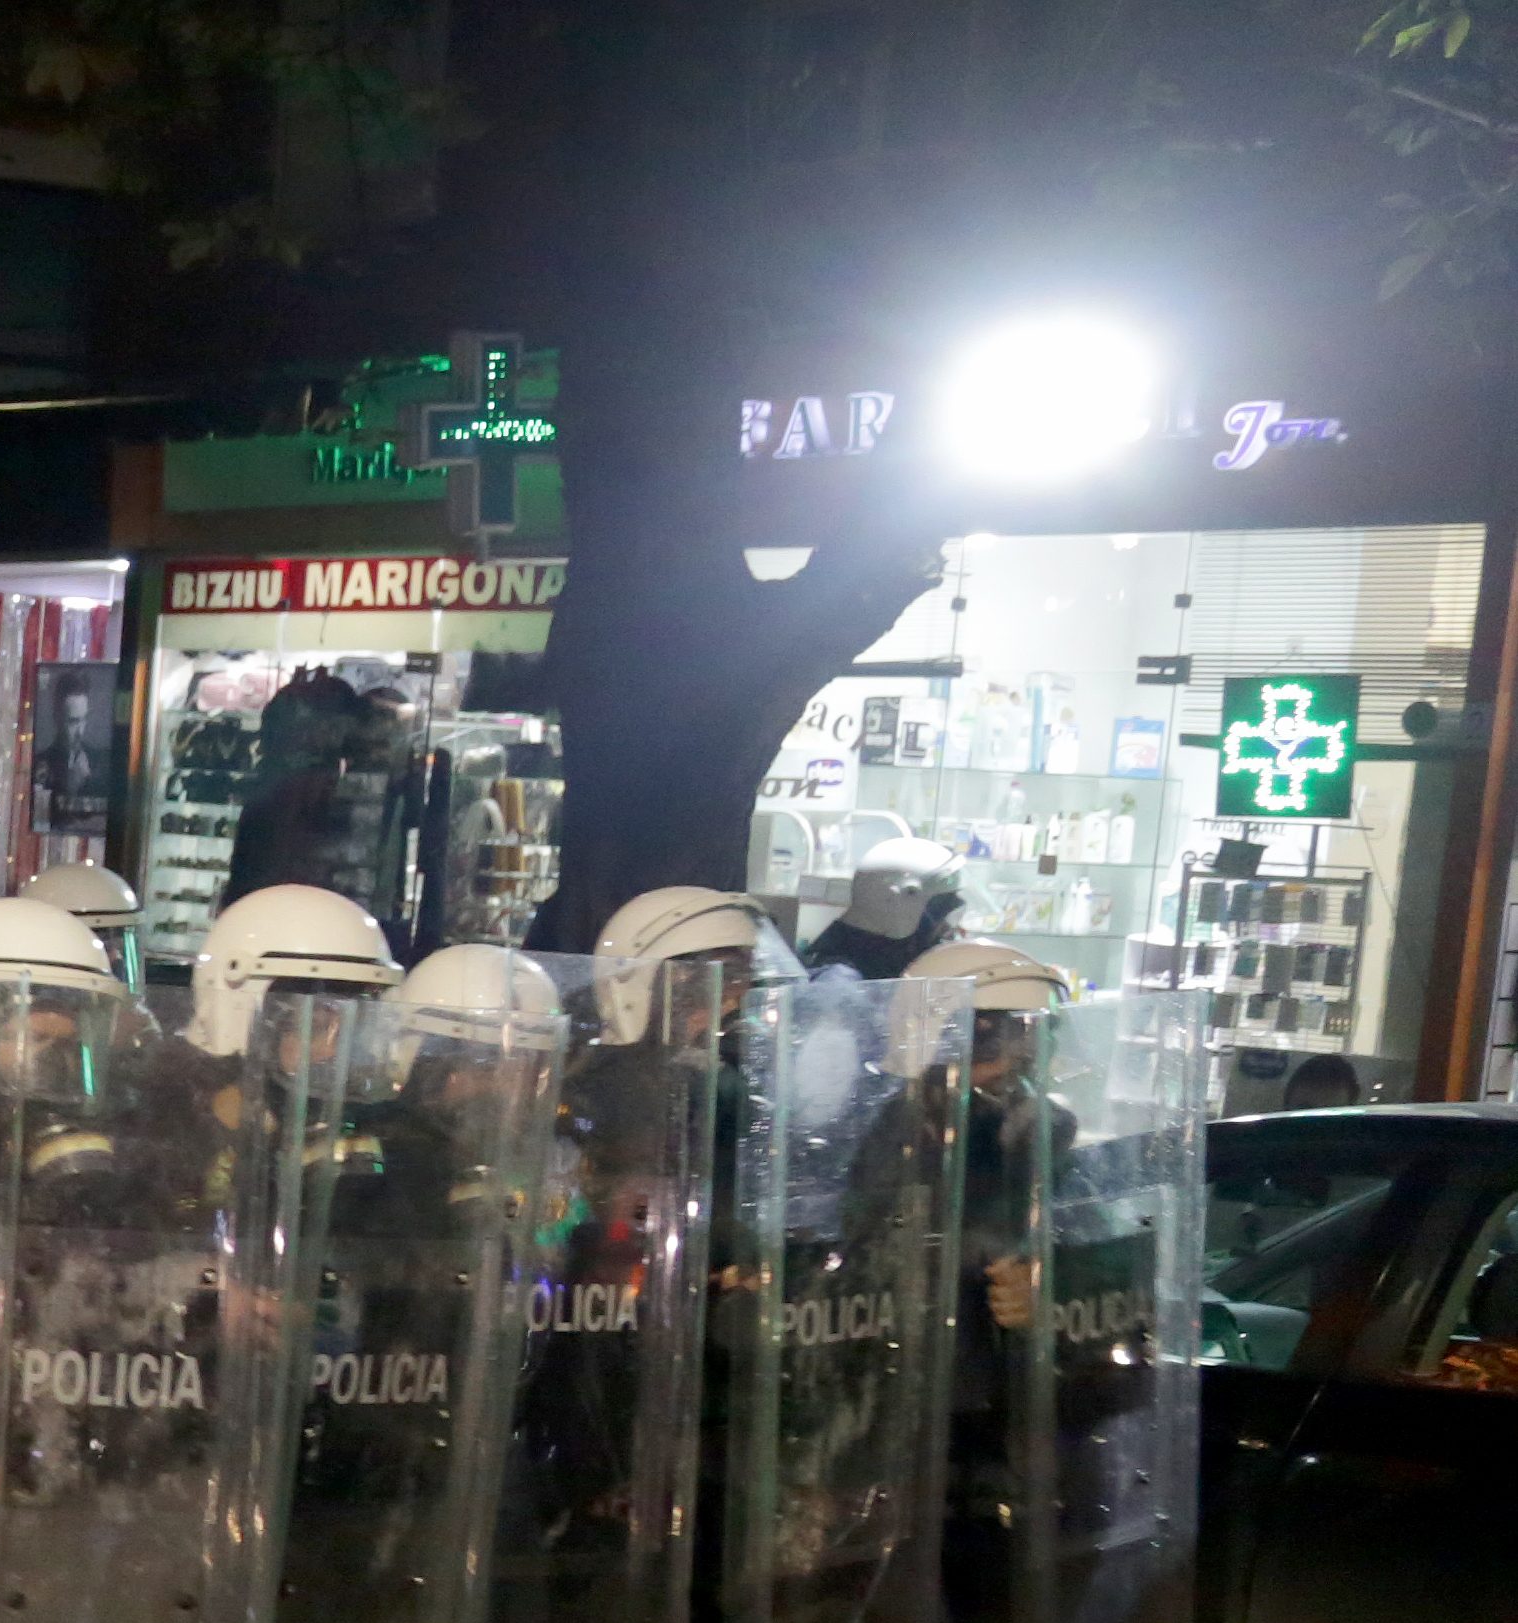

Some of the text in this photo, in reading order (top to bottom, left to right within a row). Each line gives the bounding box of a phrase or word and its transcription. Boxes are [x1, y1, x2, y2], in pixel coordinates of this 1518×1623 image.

[171, 568, 284, 609] BIZHU
[21, 1349, 205, 1410] POLICIA
[311, 1352, 448, 1405] POLICIA
